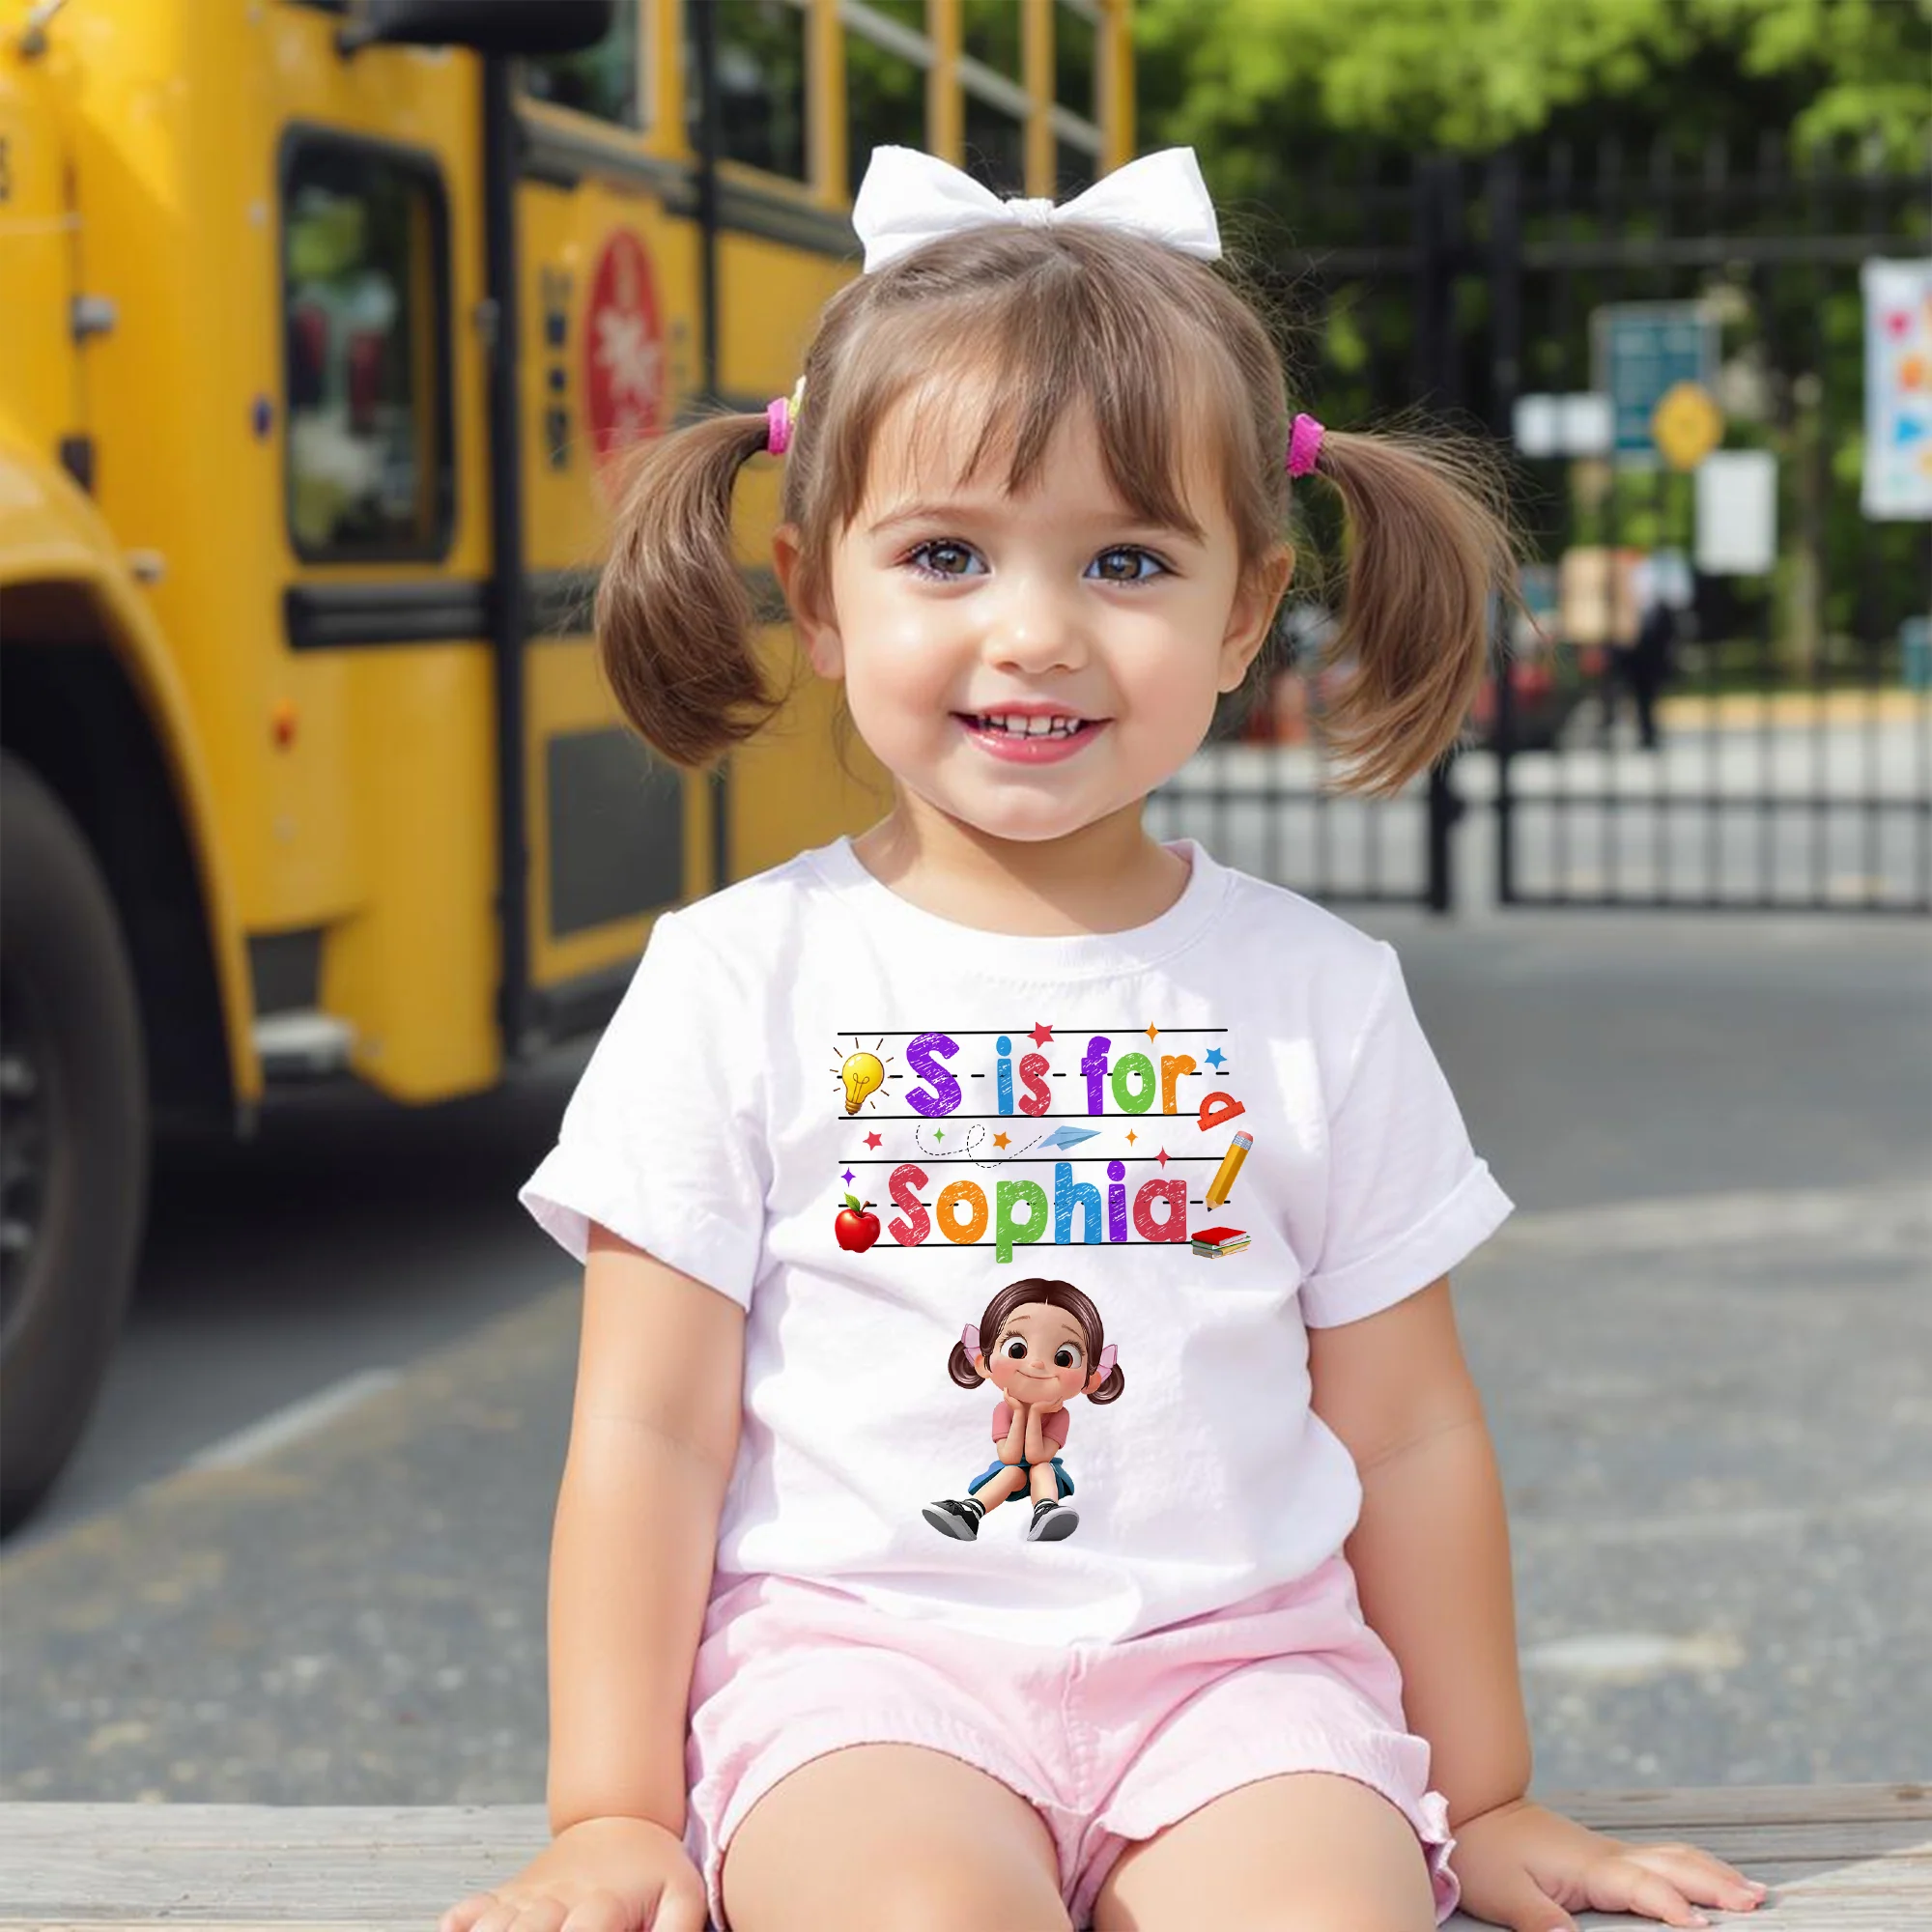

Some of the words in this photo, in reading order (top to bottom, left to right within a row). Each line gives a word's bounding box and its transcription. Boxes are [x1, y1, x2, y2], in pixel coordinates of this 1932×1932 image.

[905, 1032, 962, 1117] S
[996, 1036, 1052, 1117] is
[1081, 1036, 1197, 1116] for
[888, 1160, 1187, 1264] Sophia
